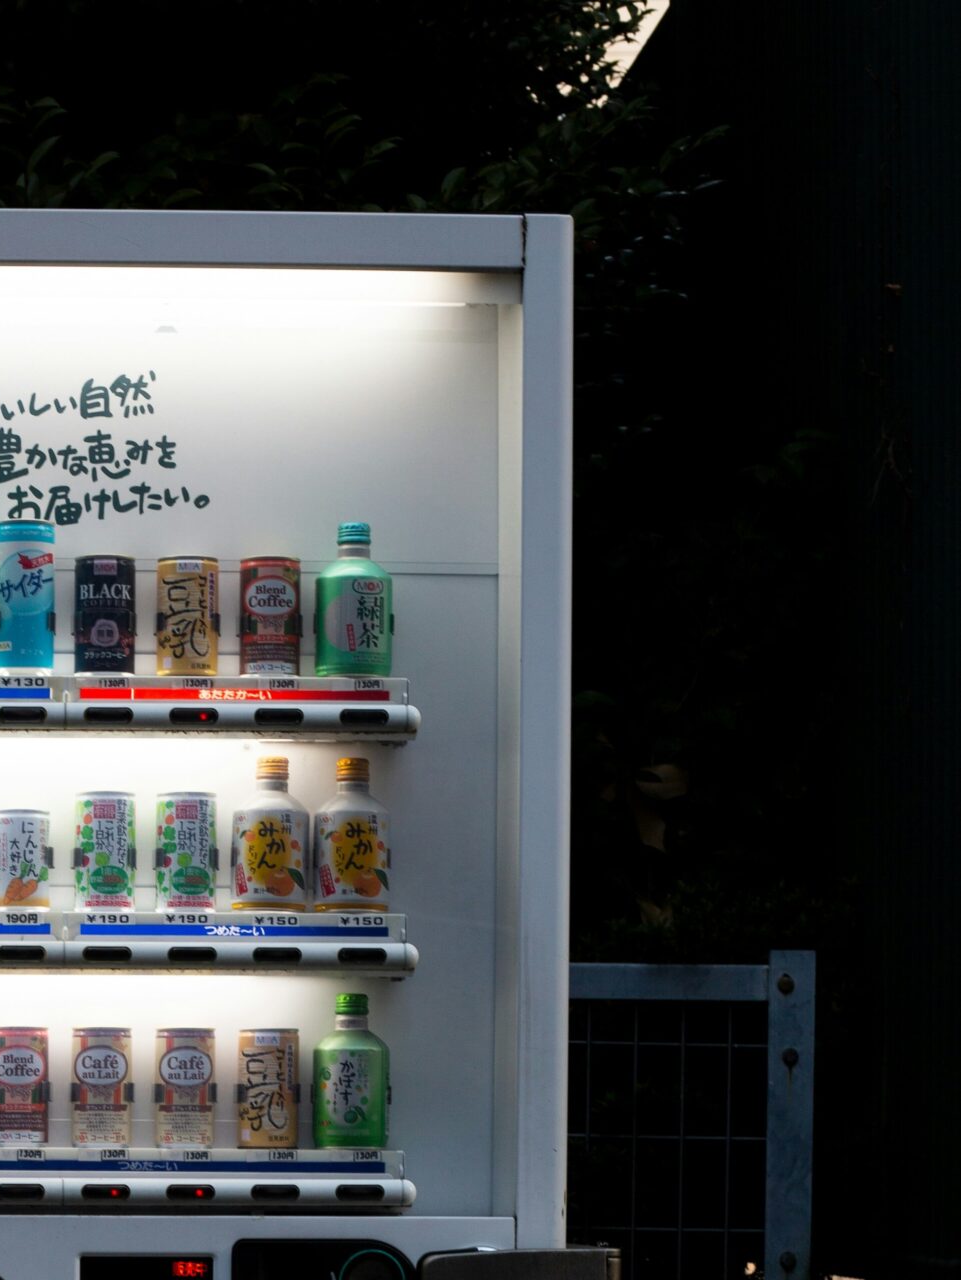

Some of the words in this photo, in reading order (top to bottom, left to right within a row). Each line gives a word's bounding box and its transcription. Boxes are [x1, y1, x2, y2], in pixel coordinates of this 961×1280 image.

[7, 481, 210, 525] お届けしたい。
[0, 570, 54, 603] サイダー
[255, 585, 286, 594] Blend
[80, 584, 131, 600] BLACK
[248, 595, 293, 608] Coffee
[356, 596, 379, 648] 緑茶
[1, 678, 45, 686] ¥130
[103, 679, 126, 687] 130円
[185, 679, 208, 687] 130円
[271, 680, 295, 688] 130円
[357, 680, 380, 688] 130円
[22, 821, 38, 878] にんじん
[257, 822, 286, 869] みかん
[345, 822, 373, 870] みかん
[9, 838, 22, 876] 大好き
[248, 846, 257, 874] ドリンク
[336, 846, 344, 875] ドリンク
[6, 913, 38, 923] 190円
[87, 915, 129, 923] ¥190
[166, 915, 207, 923] ¥190
[254, 916, 298, 925] ¥150
[340, 916, 383, 925] ¥150
[3, 1055, 34, 1063] Blend
[82, 1055, 119, 1069] Café
[167, 1056, 204, 1070] Café
[98, 1070, 120, 1079] Lait
[183, 1071, 205, 1080] Lait
[19, 1150, 42, 1158] 130円
[103, 1150, 126, 1158] 130円
[186, 1151, 209, 1160] 130円
[272, 1152, 294, 1160] 130円
[355, 1152, 378, 1160] 130円
